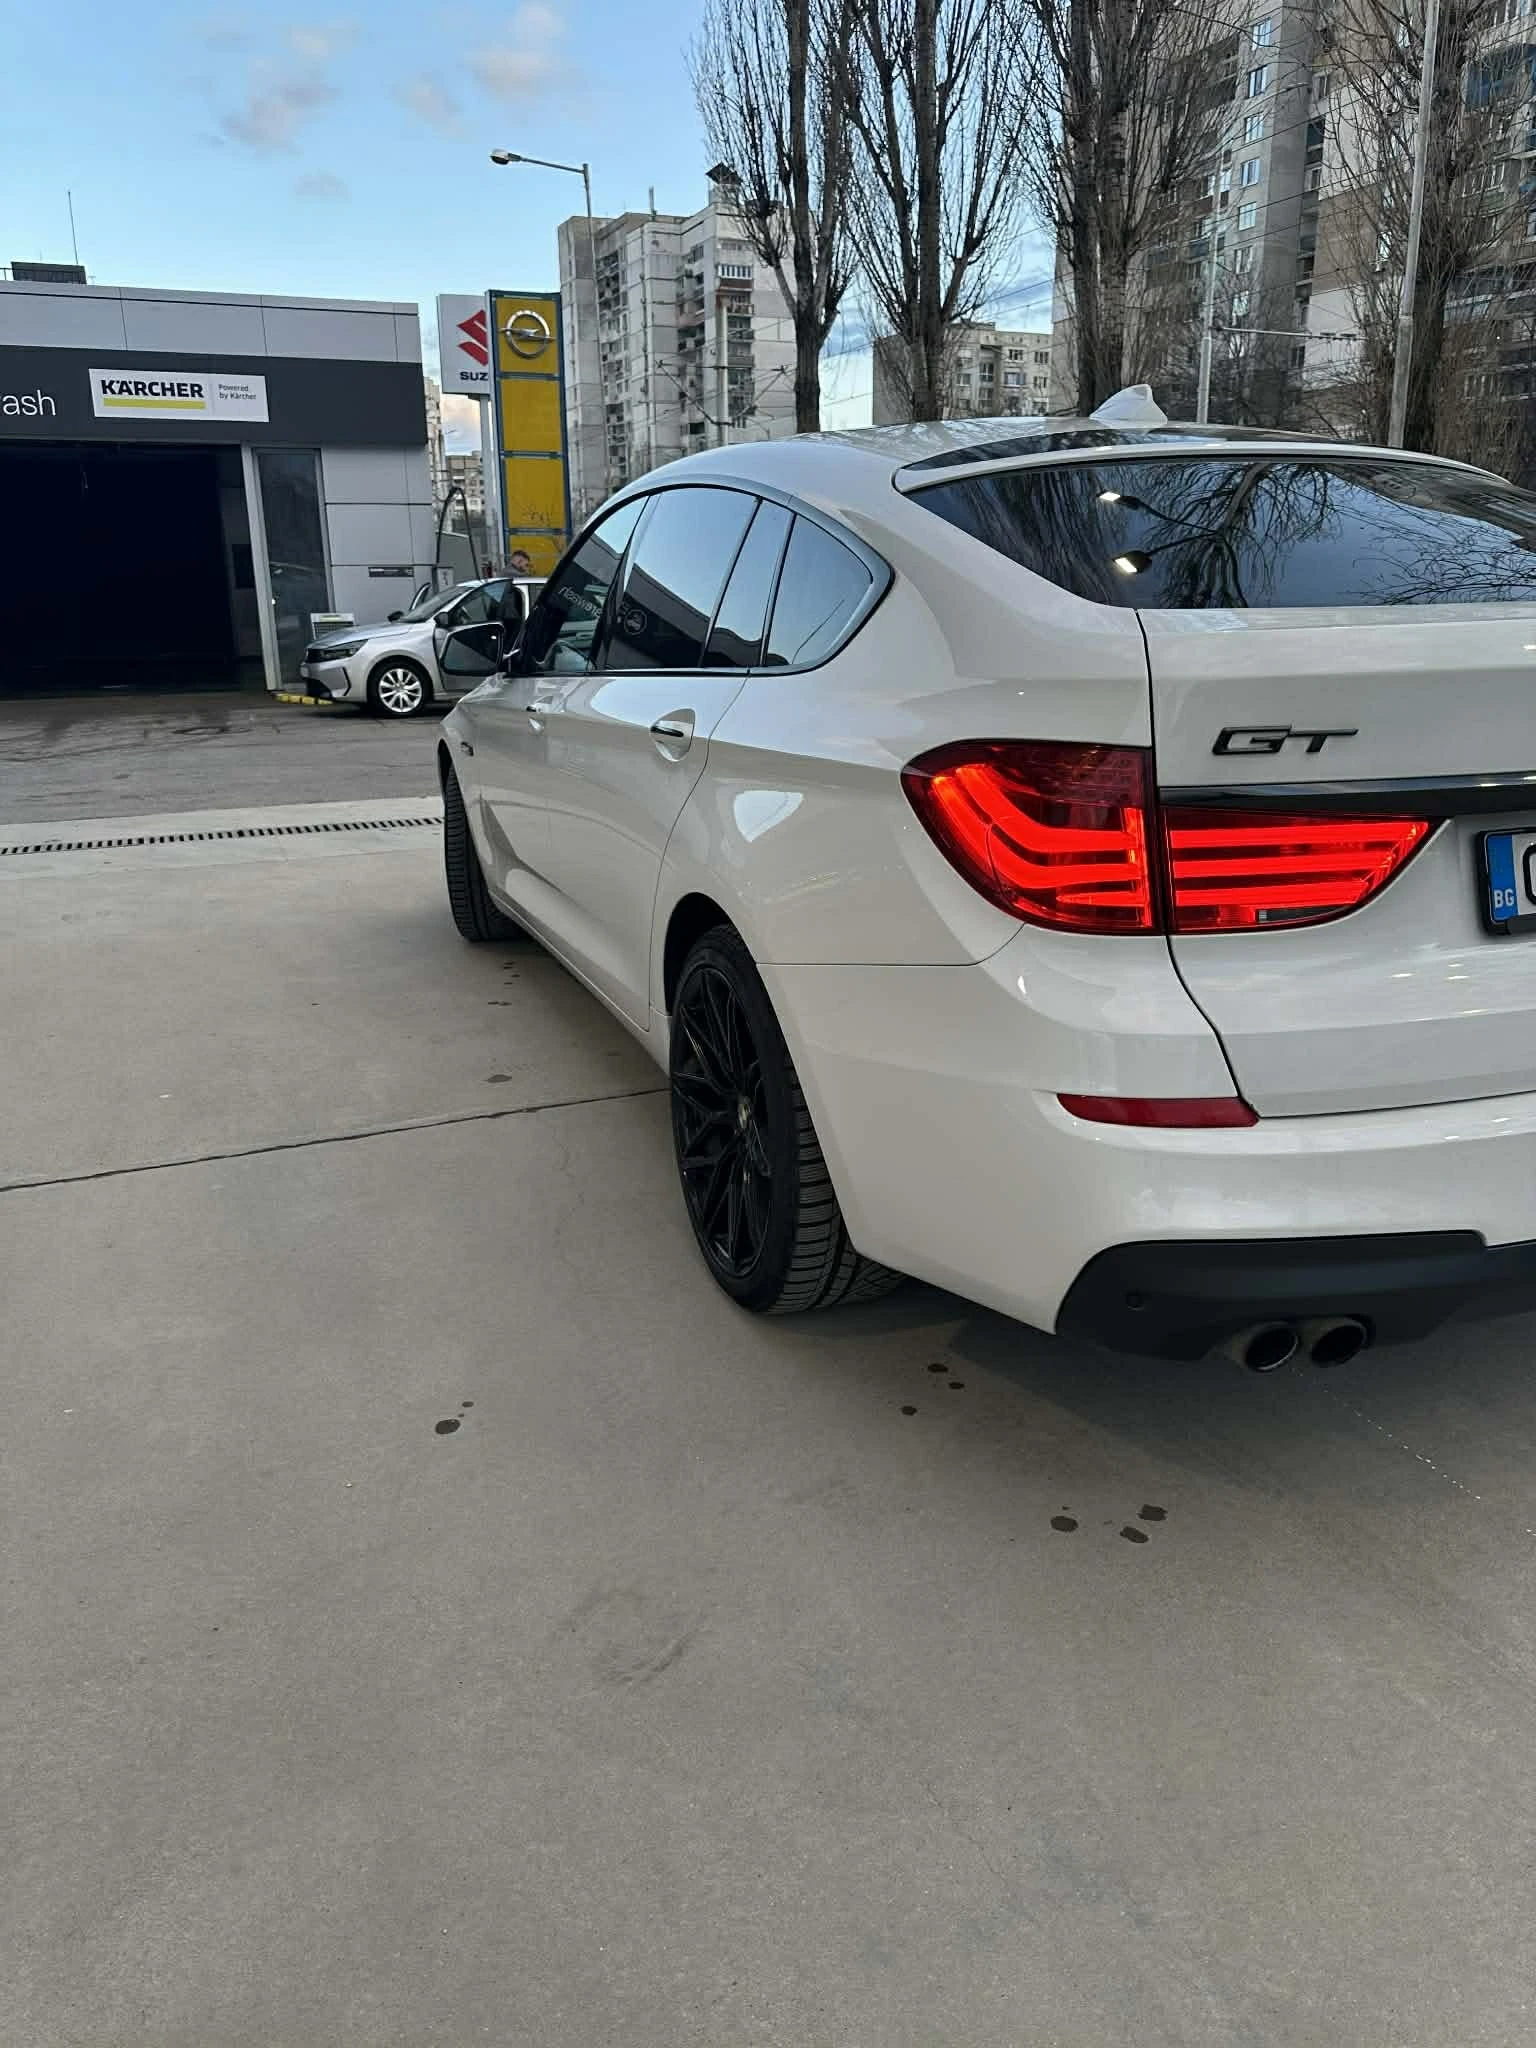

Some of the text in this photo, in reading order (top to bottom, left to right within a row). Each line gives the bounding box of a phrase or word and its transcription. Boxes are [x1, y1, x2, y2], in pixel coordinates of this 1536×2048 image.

[101, 379, 204, 398] KÄRCHER
[218, 384, 249, 392] Powered
[219, 392, 229, 400] by
[0, 389, 56, 416] ash
[1212, 725, 1359, 755] GT
[1493, 889, 1515, 908] BG
